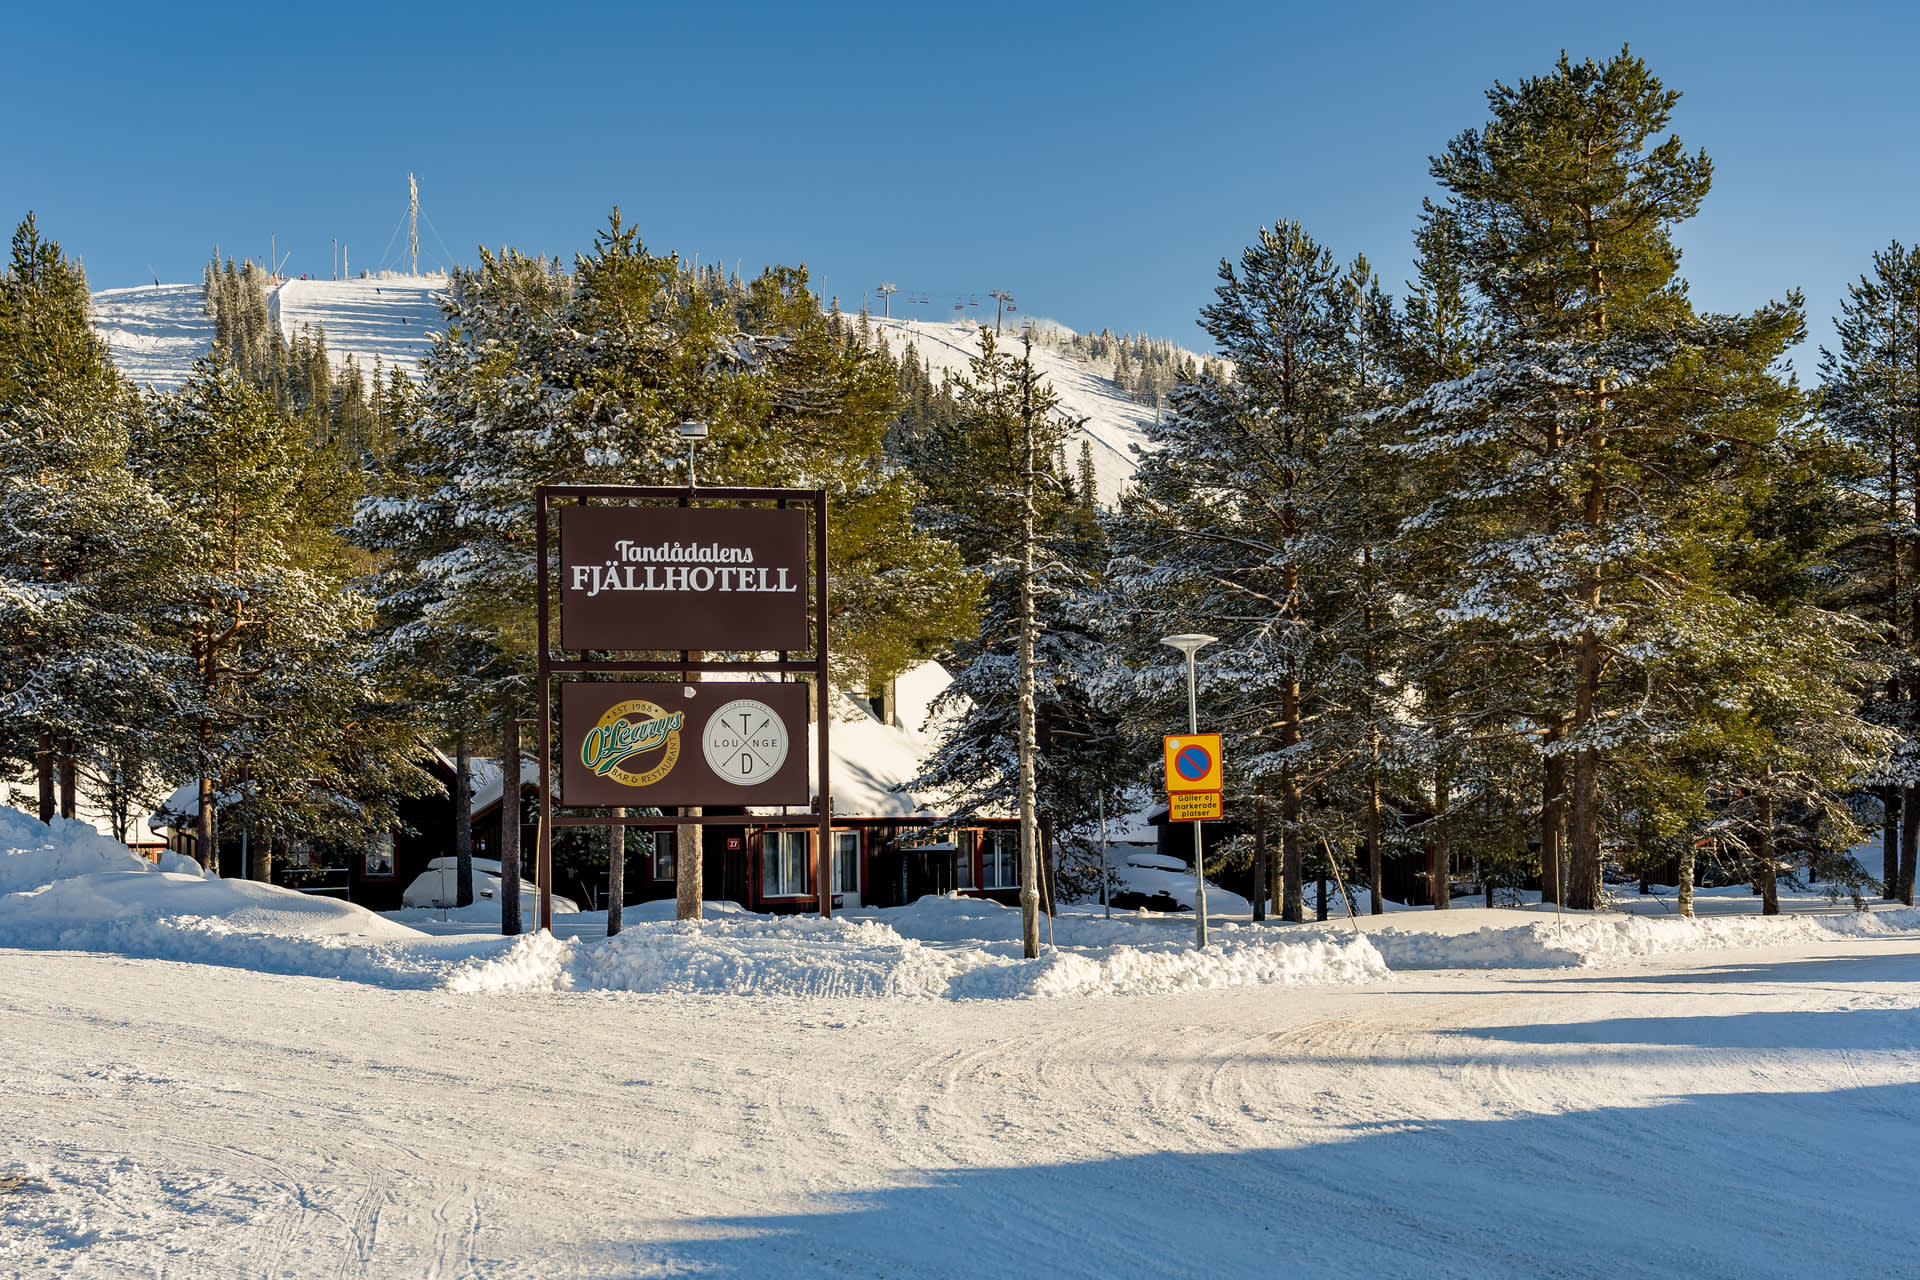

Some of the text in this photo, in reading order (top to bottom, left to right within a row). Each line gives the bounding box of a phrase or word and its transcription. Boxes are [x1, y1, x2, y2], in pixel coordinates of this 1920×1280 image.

[615, 540, 754, 563] Tandådalens
[570, 560, 798, 597] FJÄLLHOTELL
[612, 703, 653, 717] EST 1988
[739, 713, 752, 735] T
[582, 711, 683, 774] O'Learys
[611, 768, 629, 783] BAR
[641, 736, 677, 783] RESTAURANT
[741, 753, 753, 774] D
[1174, 802, 1217, 810] markerade
[1181, 810, 1210, 818] platser
